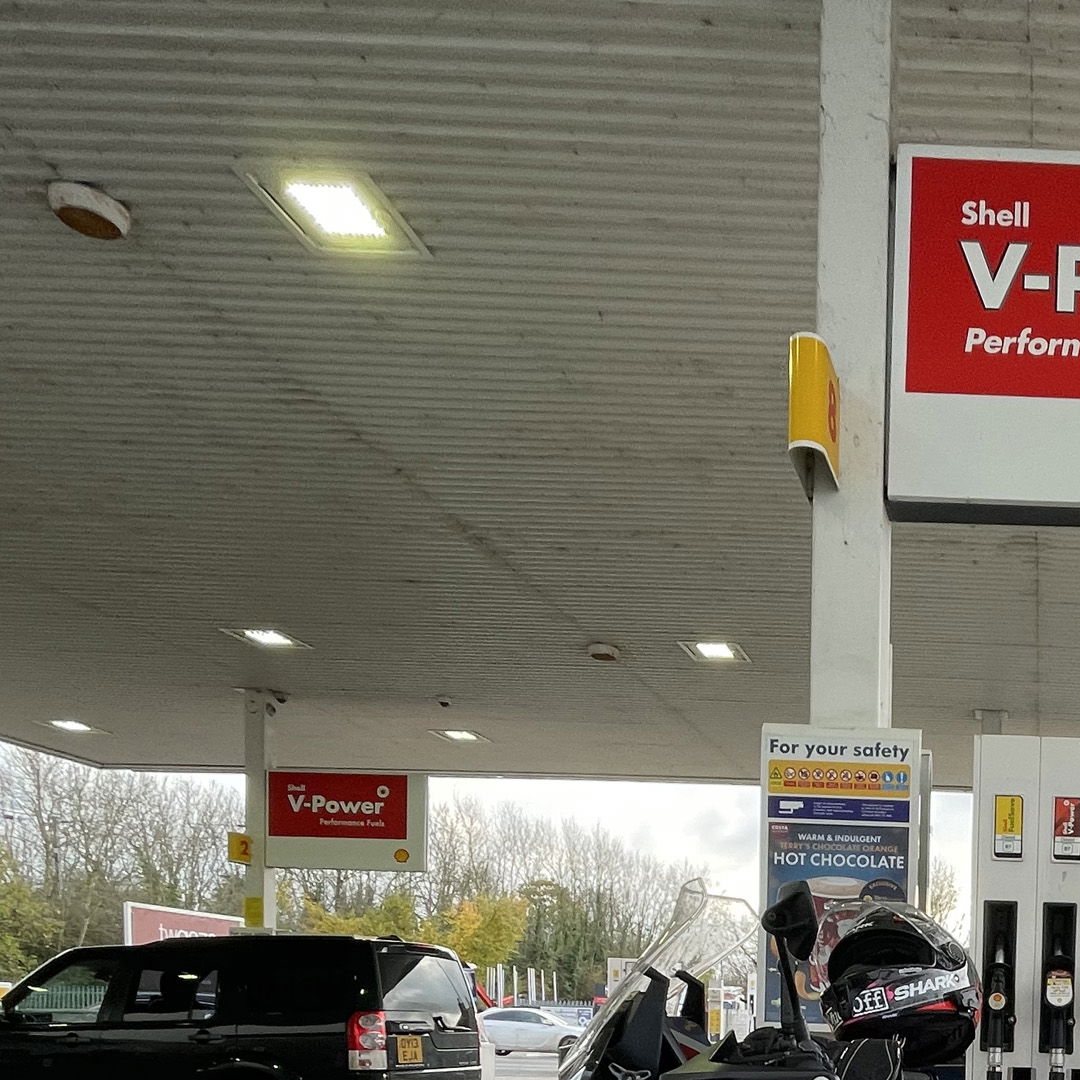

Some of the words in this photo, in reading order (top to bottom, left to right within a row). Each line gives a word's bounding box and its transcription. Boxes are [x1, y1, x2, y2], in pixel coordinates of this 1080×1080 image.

[960, 200, 1030, 228] Shell
[769, 739, 799, 754] For
[805, 744, 848, 758] your
[853, 742, 910, 762] safety
[287, 794, 385, 814] V-Power
[319, 818, 365, 827] Performance
[366, 819, 385, 827] Fuels
[1067, 803, 1075, 835] V-Power
[798, 833, 824, 841] WARM
[826, 834, 833, 842] &
[834, 835, 881, 843] INDULGENT
[240, 841, 248, 855] 2
[862, 845, 898, 854] ORANGE
[773, 852, 807, 866] HOT
[810, 853, 905, 869] CHOCOLATE
[894, 975, 956, 1001] SHARK
